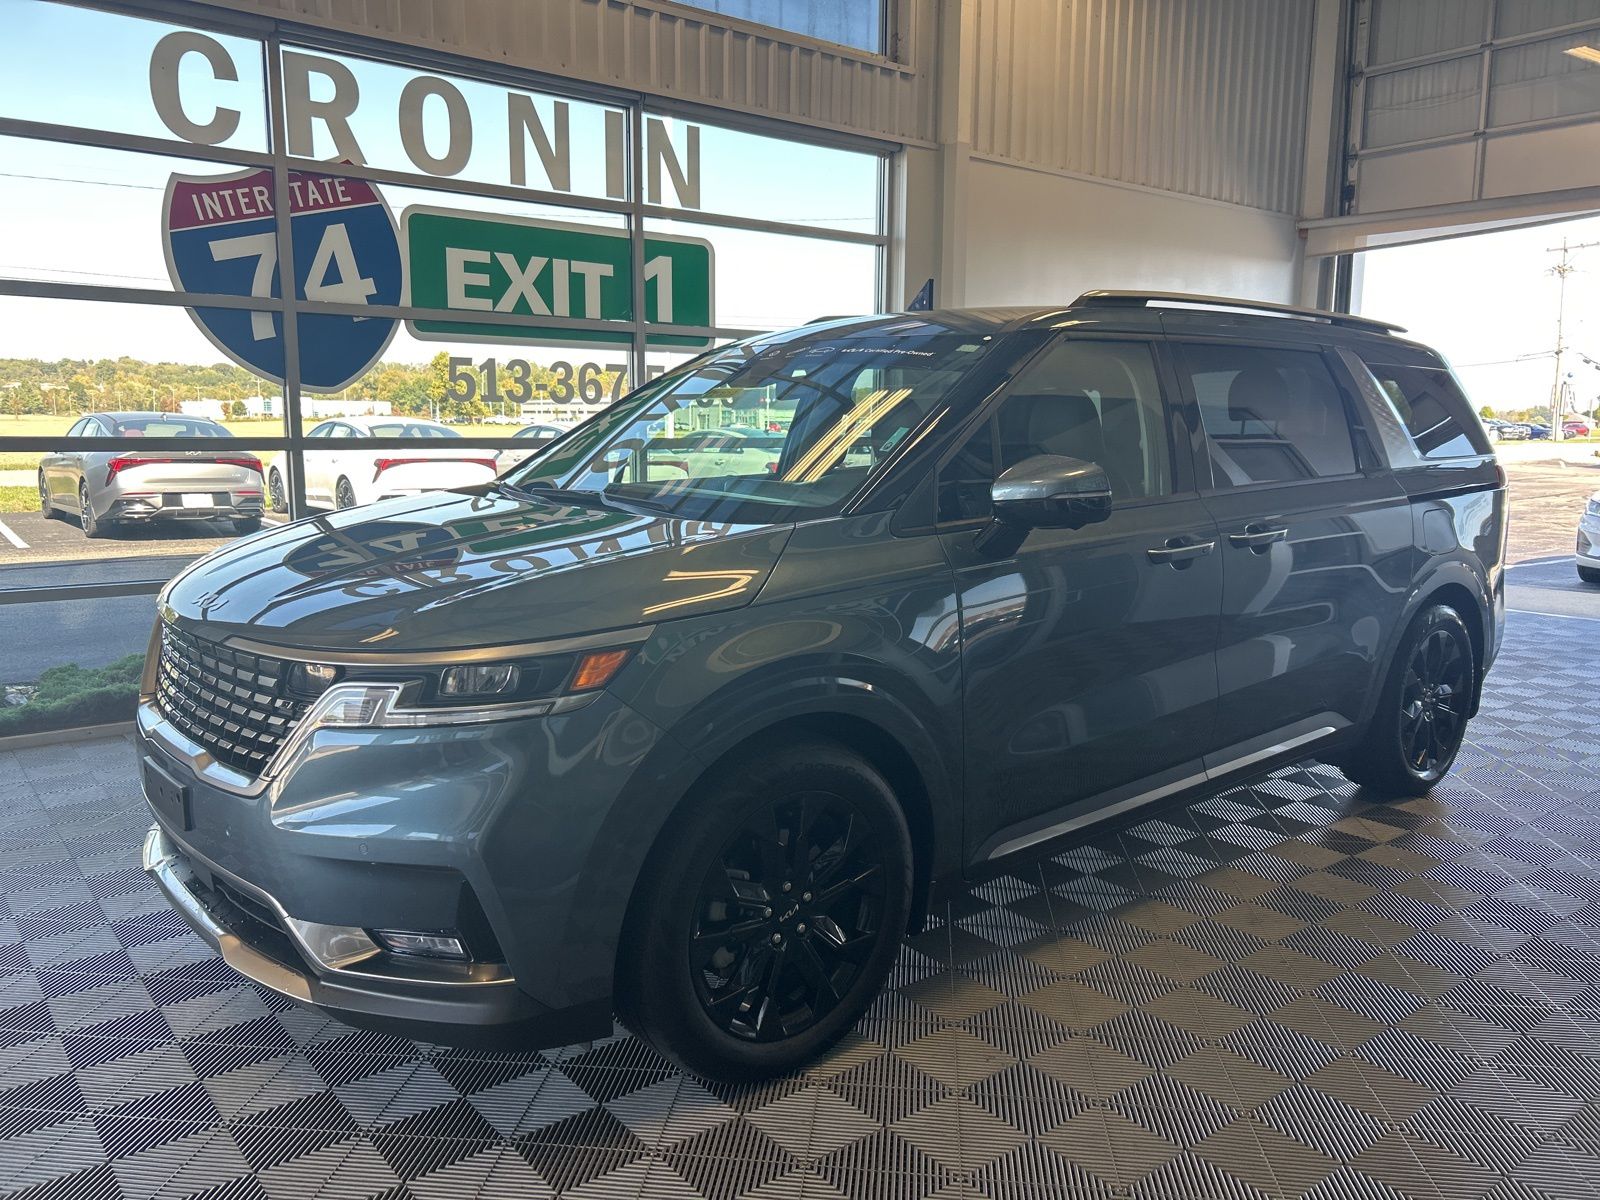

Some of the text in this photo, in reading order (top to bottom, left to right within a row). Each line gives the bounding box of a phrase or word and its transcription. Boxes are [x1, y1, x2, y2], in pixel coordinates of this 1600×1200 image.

[149, 30, 701, 210] CRONIN
[191, 177, 352, 221] INTERTATE
[208, 222, 378, 342] 74
[445, 247, 674, 323] EXIT 1
